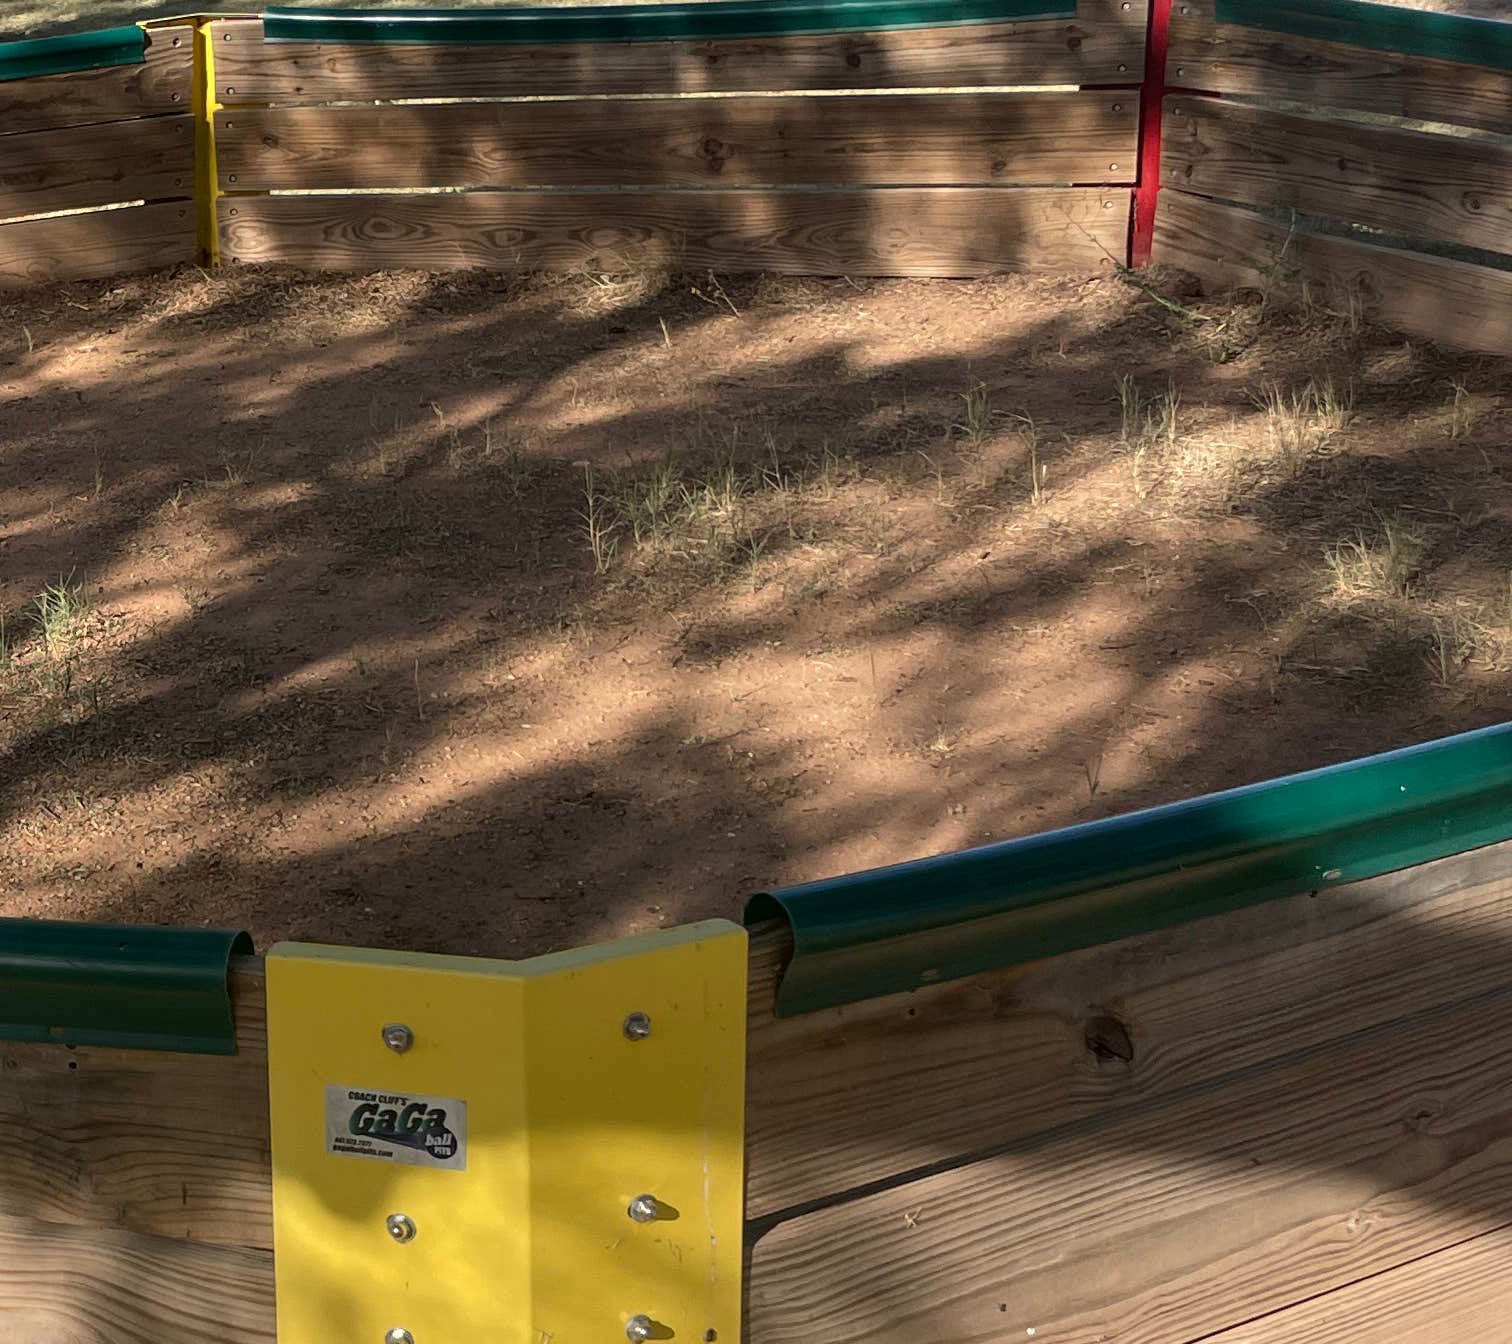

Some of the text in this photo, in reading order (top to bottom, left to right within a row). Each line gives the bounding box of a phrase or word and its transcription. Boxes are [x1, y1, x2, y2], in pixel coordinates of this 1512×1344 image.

[348, 1091, 376, 1102] COACH
[349, 1102, 447, 1135] GaGa
[425, 1133, 452, 1146] ball
